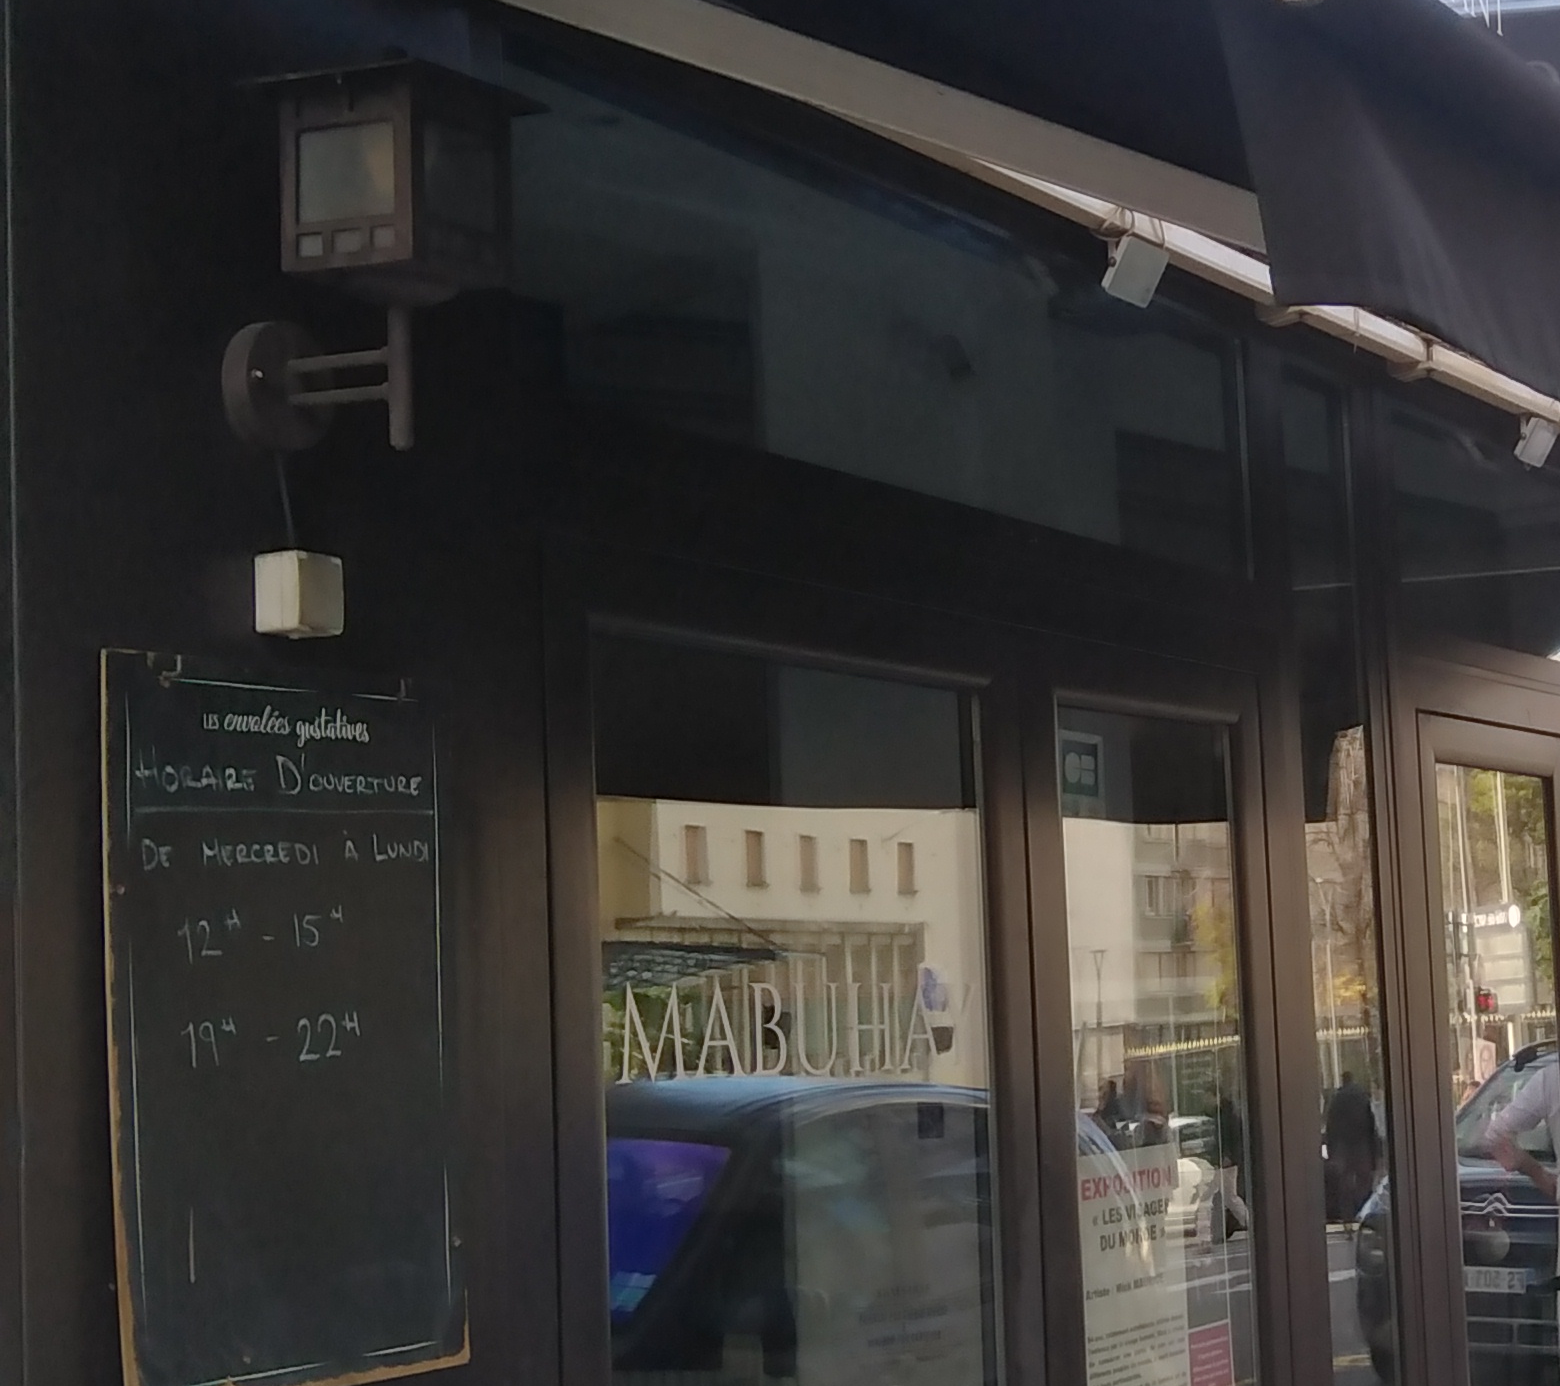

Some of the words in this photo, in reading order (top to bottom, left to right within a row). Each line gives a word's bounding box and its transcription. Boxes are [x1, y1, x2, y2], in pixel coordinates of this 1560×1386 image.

[203, 713, 219, 730] LES
[296, 707, 371, 747] gustatives
[1102, 1207, 1123, 1225] LES
[1099, 1232, 1116, 1252] DU
